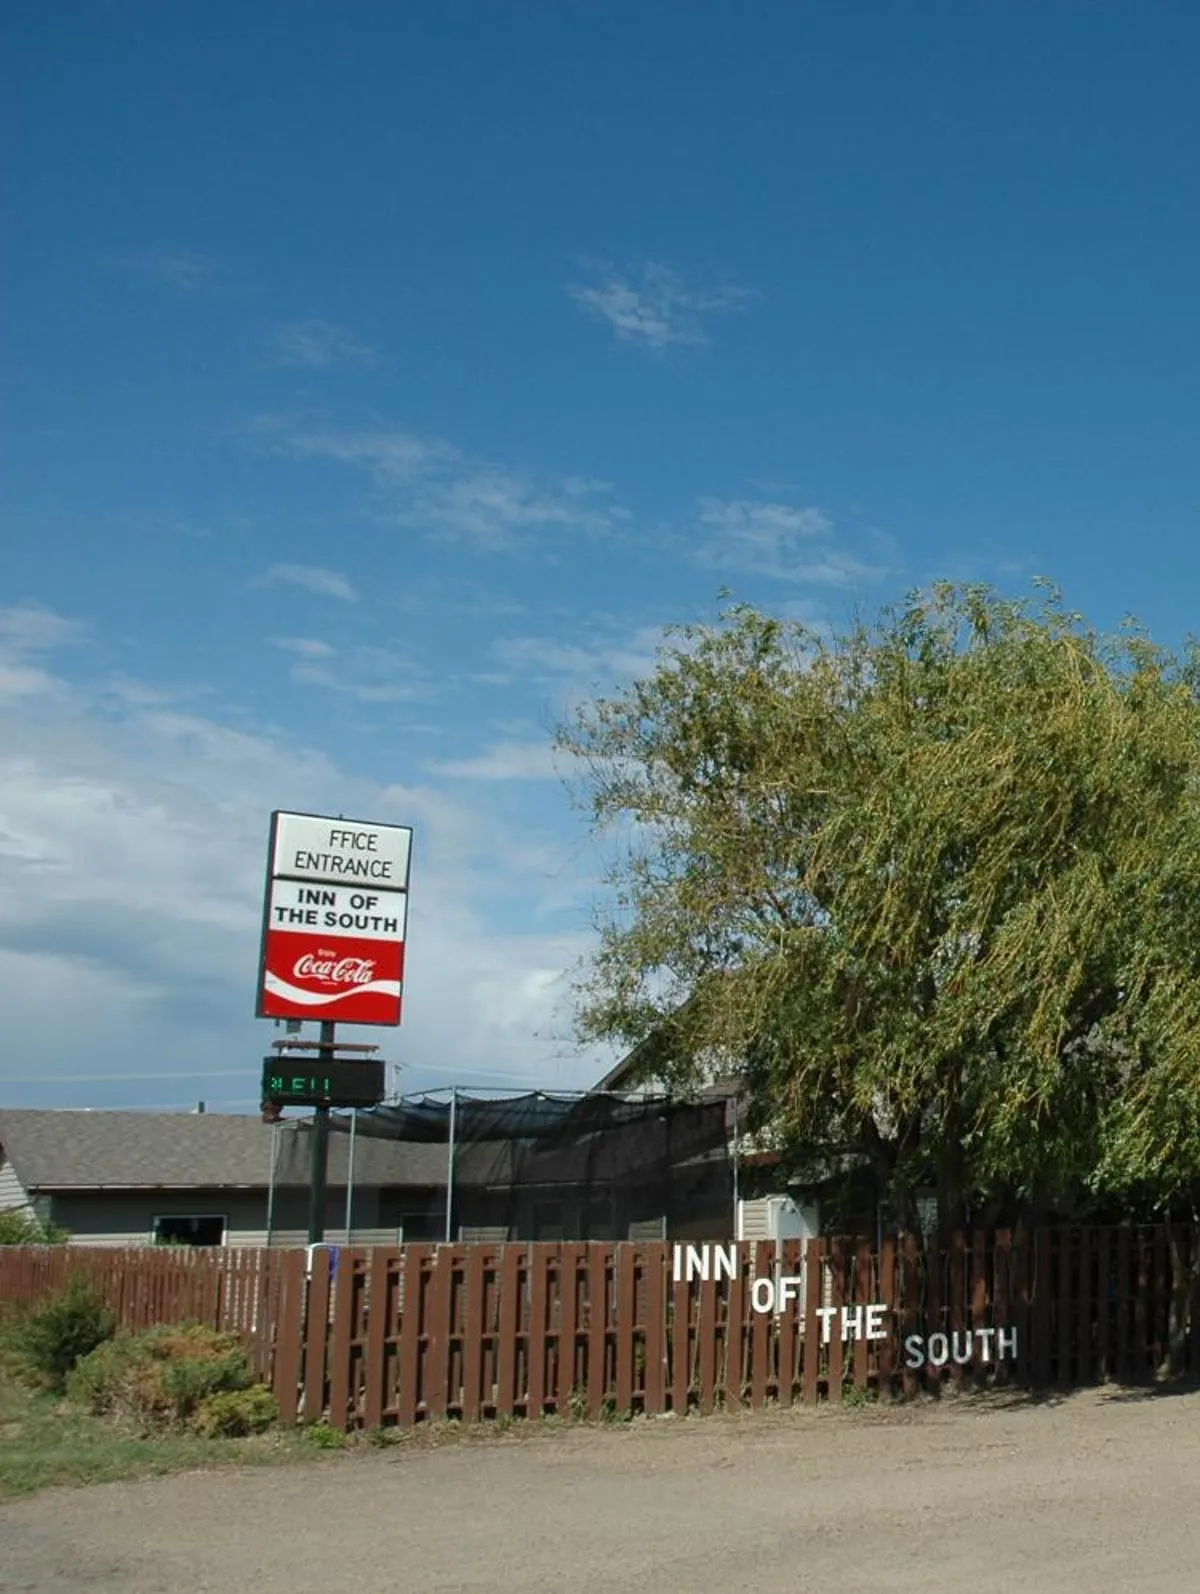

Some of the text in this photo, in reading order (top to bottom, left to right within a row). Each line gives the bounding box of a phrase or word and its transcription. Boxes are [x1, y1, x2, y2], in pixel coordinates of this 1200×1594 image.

[329, 830, 378, 852] FFICE
[294, 851, 393, 879] ENTRANCE
[298, 888, 379, 911] INN OF
[274, 906, 398, 933] THE SOUTH
[673, 1244, 1018, 1369] INN OF THE SOUTH
